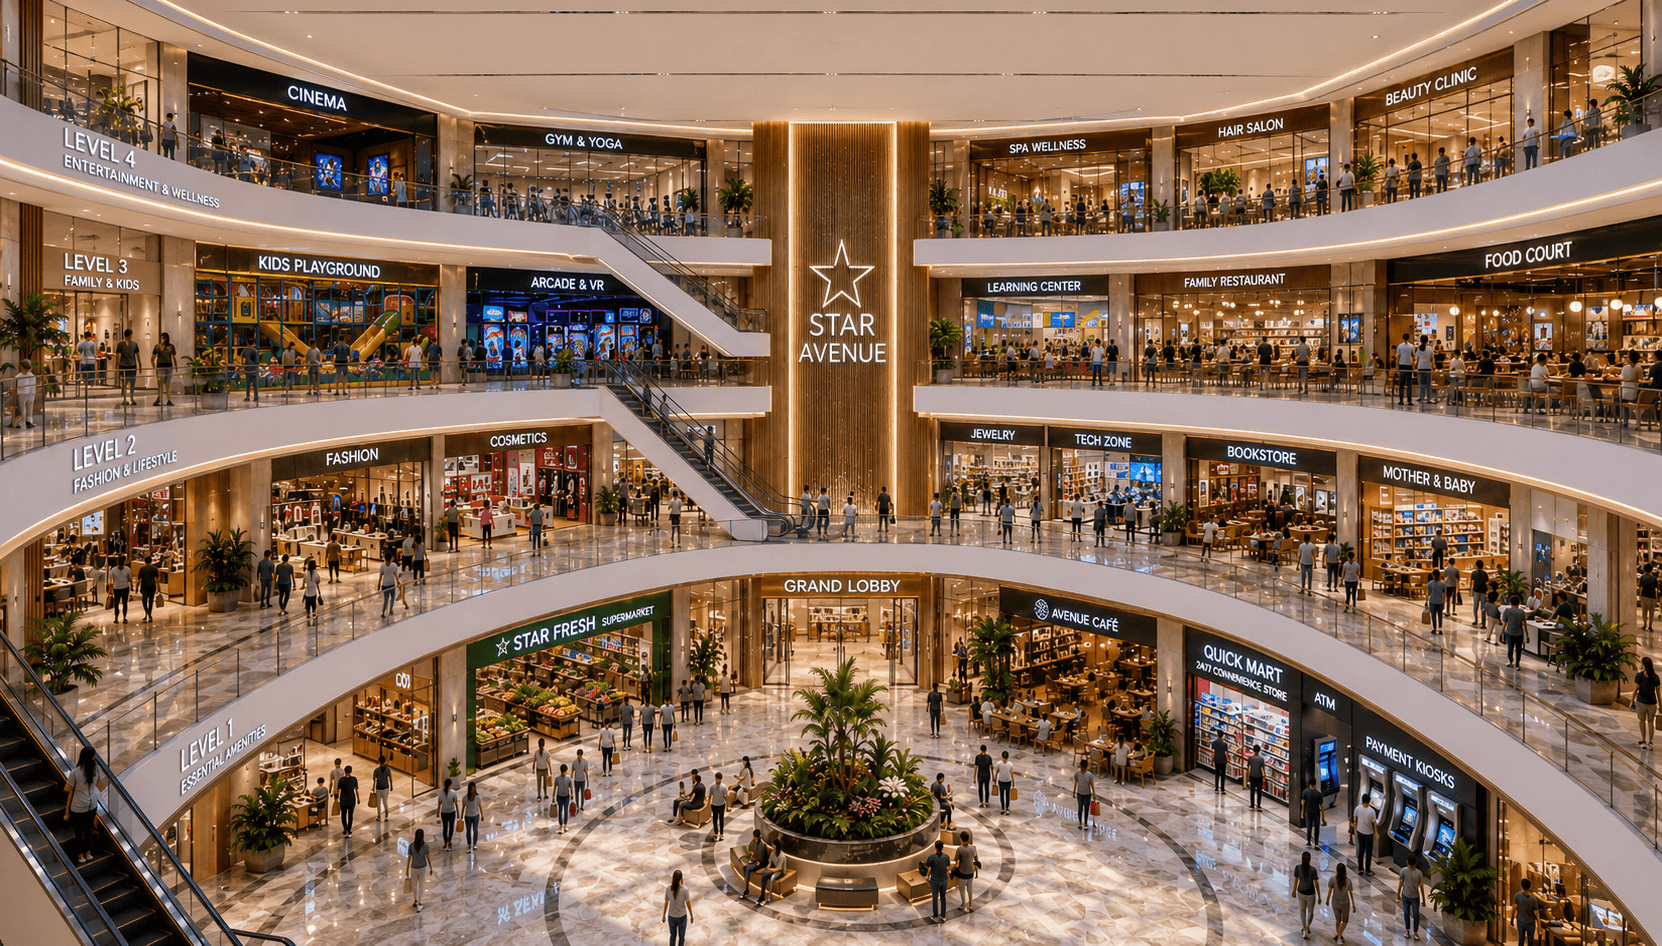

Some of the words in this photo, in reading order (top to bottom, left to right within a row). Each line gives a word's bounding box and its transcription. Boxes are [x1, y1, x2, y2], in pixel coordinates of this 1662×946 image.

[1385, 80, 1432, 107] BEAUTY
[1434, 66, 1477, 91] CLINIC
[287, 85, 348, 112] CINEMA
[1218, 124, 1244, 138] HAIR
[1246, 117, 1284, 134] SALON
[64, 127, 120, 164] LEVEL
[124, 150, 137, 168] 4
[545, 133, 573, 146] GYM
[576, 135, 586, 147] &
[588, 136, 623, 150] YOGA
[1009, 143, 1029, 154] SPA
[1031, 138, 1087, 153] WELLNESS
[64, 153, 160, 193] ENTERTAINMENT
[161, 183, 169, 196] &
[171, 186, 220, 209] WELLNESS
[64, 252, 114, 273] LEVEL
[118, 258, 128, 274] 3
[1485, 249, 1522, 269] FOOD
[1525, 240, 1573, 263] COURT
[258, 255, 291, 272] KIDS
[294, 258, 381, 279] PLAYGROUND
[64, 274, 103, 288] FAMILY
[105, 277, 114, 289] &
[116, 278, 140, 291] KIDS
[530, 276, 576, 290] ARCADE
[578, 278, 587, 291] &
[589, 279, 605, 291] VR
[987, 281, 1038, 293] LEARNING
[1040, 280, 1081, 292] CENTER
[1184, 276, 1218, 288] FAMILY
[1220, 272, 1286, 287] RESTAURANT
[809, 312, 875, 337] STAR
[798, 342, 887, 363] AVENUE
[489, 431, 548, 448] COSMETICS
[970, 428, 1016, 441] JEWELRY
[1074, 433, 1102, 446] TECH
[1103, 435, 1132, 449] ZONE
[74, 438, 123, 472] LEVEL
[127, 434, 136, 456] 2
[326, 447, 379, 466] FASHION
[1227, 445, 1297, 465] BOOKSTORE
[74, 465, 121, 495] FASHION
[123, 463, 131, 477] &
[133, 449, 178, 474] LIFESTYLE
[1383, 465, 1431, 486] MOTHER
[1433, 474, 1442, 489] &
[1444, 475, 1476, 495] BABY
[783, 579, 843, 593] GRAND
[847, 579, 901, 593] LOBBY
[1051, 608, 1090, 626] AVENUE
[513, 627, 550, 651] STAR
[553, 616, 596, 640] FRESH
[601, 606, 655, 626] SUPERMARKET
[1203, 644, 1243, 670] QUICK
[1246, 657, 1284, 684] MART
[1262, 684, 1288, 702] STORE
[1314, 692, 1336, 711] ATM
[181, 726, 225, 773] LEVEL
[227, 717, 233, 738] 1
[181, 753, 225, 796] ESSENTIAL
[226, 723, 267, 761] AMENITIES
[1365, 735, 1414, 769] PAYMENT
[1415, 759, 1455, 789] KIOSKS
